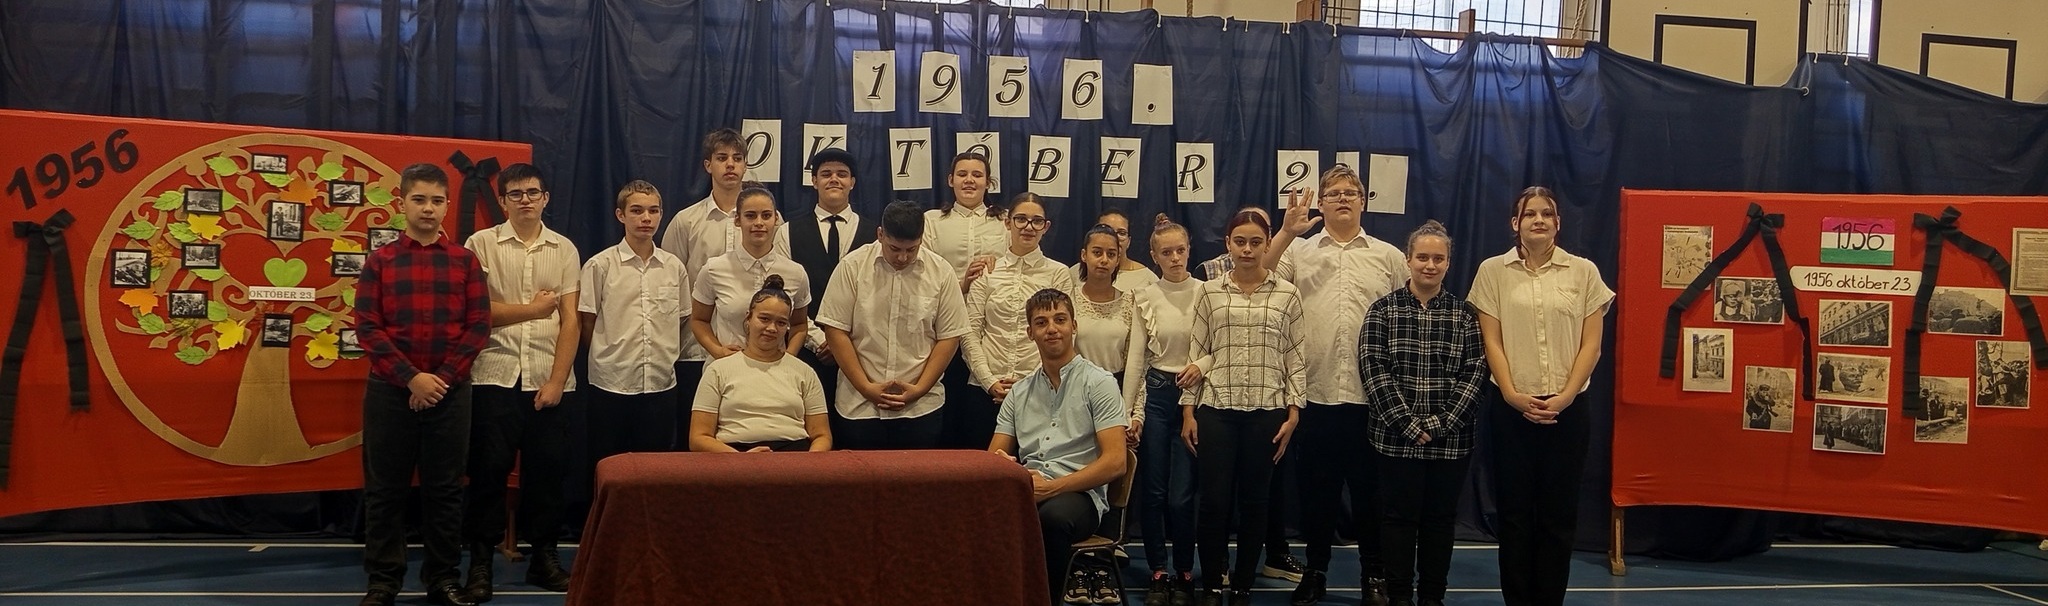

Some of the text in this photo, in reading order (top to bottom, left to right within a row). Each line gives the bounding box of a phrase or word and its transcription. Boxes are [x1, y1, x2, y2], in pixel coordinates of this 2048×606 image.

[6, 128, 139, 210] 1956
[1832, 222, 1885, 251] 1956
[1836, 275, 1889, 290] október
